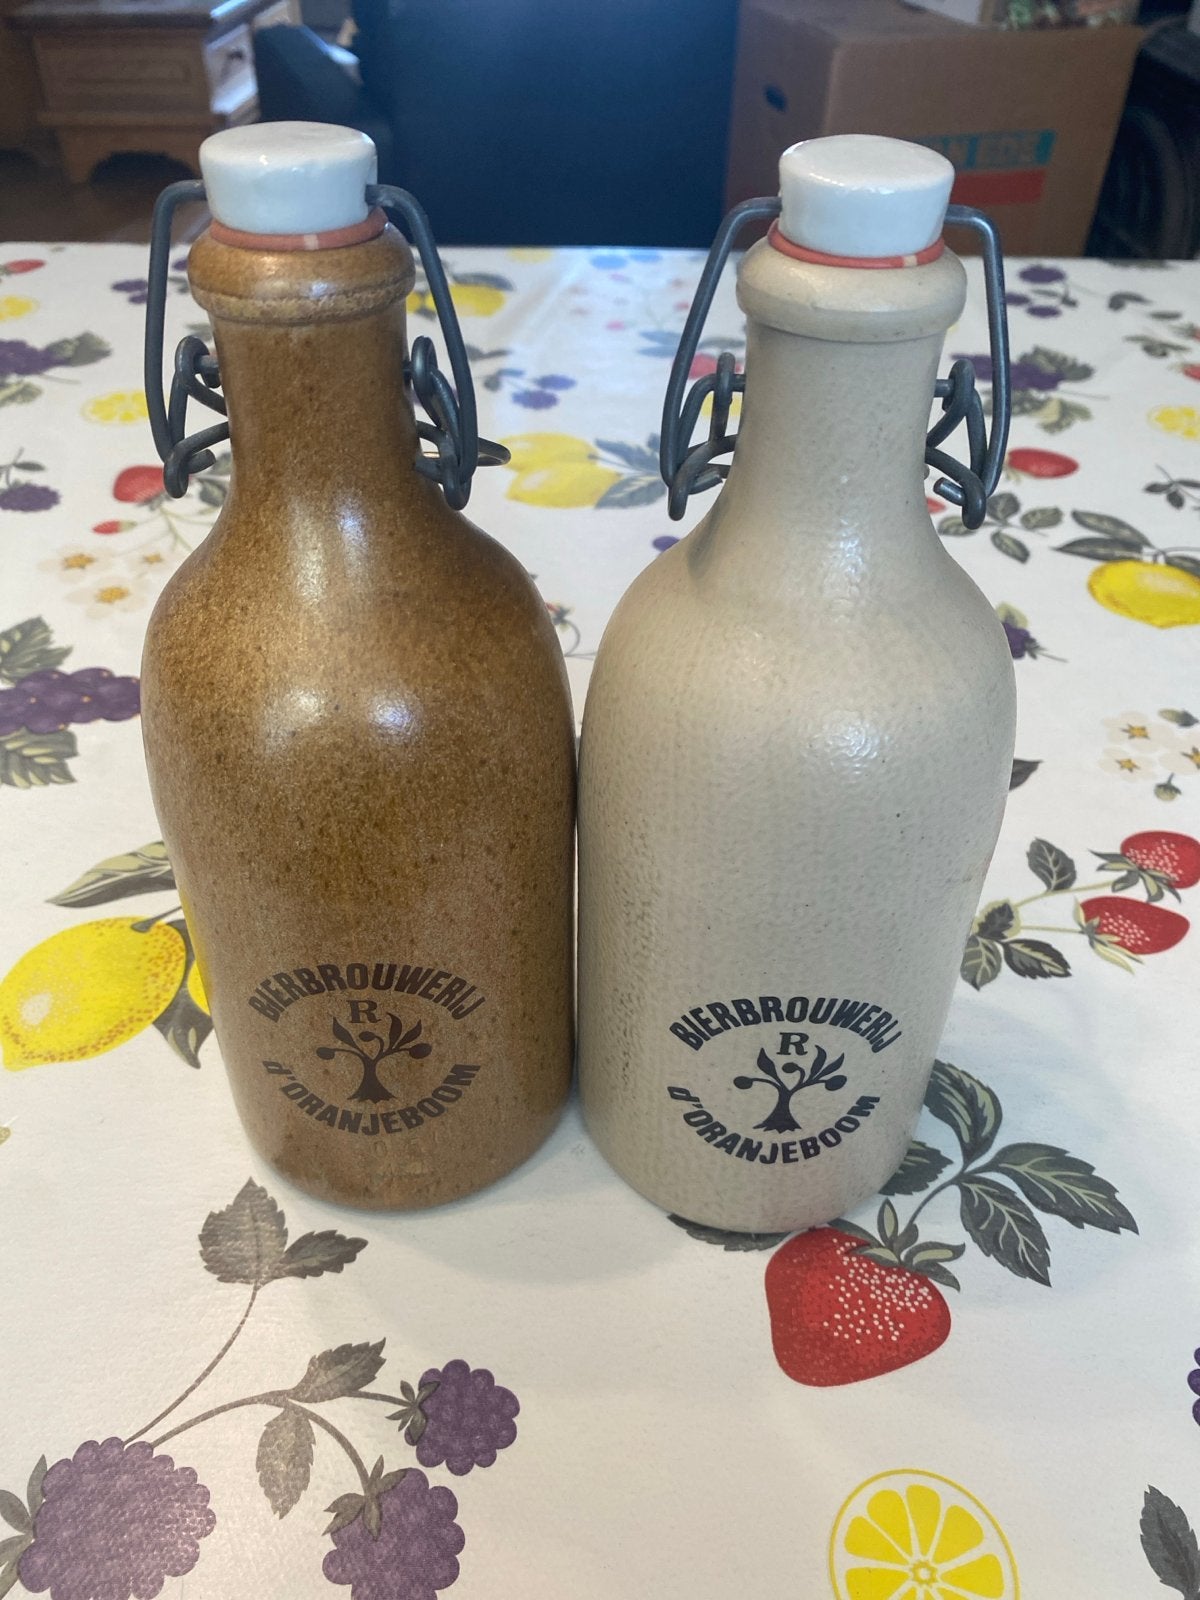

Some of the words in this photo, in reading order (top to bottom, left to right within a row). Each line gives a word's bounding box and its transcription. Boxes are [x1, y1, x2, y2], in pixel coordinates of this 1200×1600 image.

[248, 962, 486, 1023] BIERBROUWERIJ
[347, 1000, 382, 1024] R
[669, 996, 902, 1053] BIERBROUWERIJ
[776, 1032, 810, 1056] R
[262, 1060, 481, 1136] d'ORANJEBOOM
[667, 1086, 880, 1164] d'ORANJEBOOM
